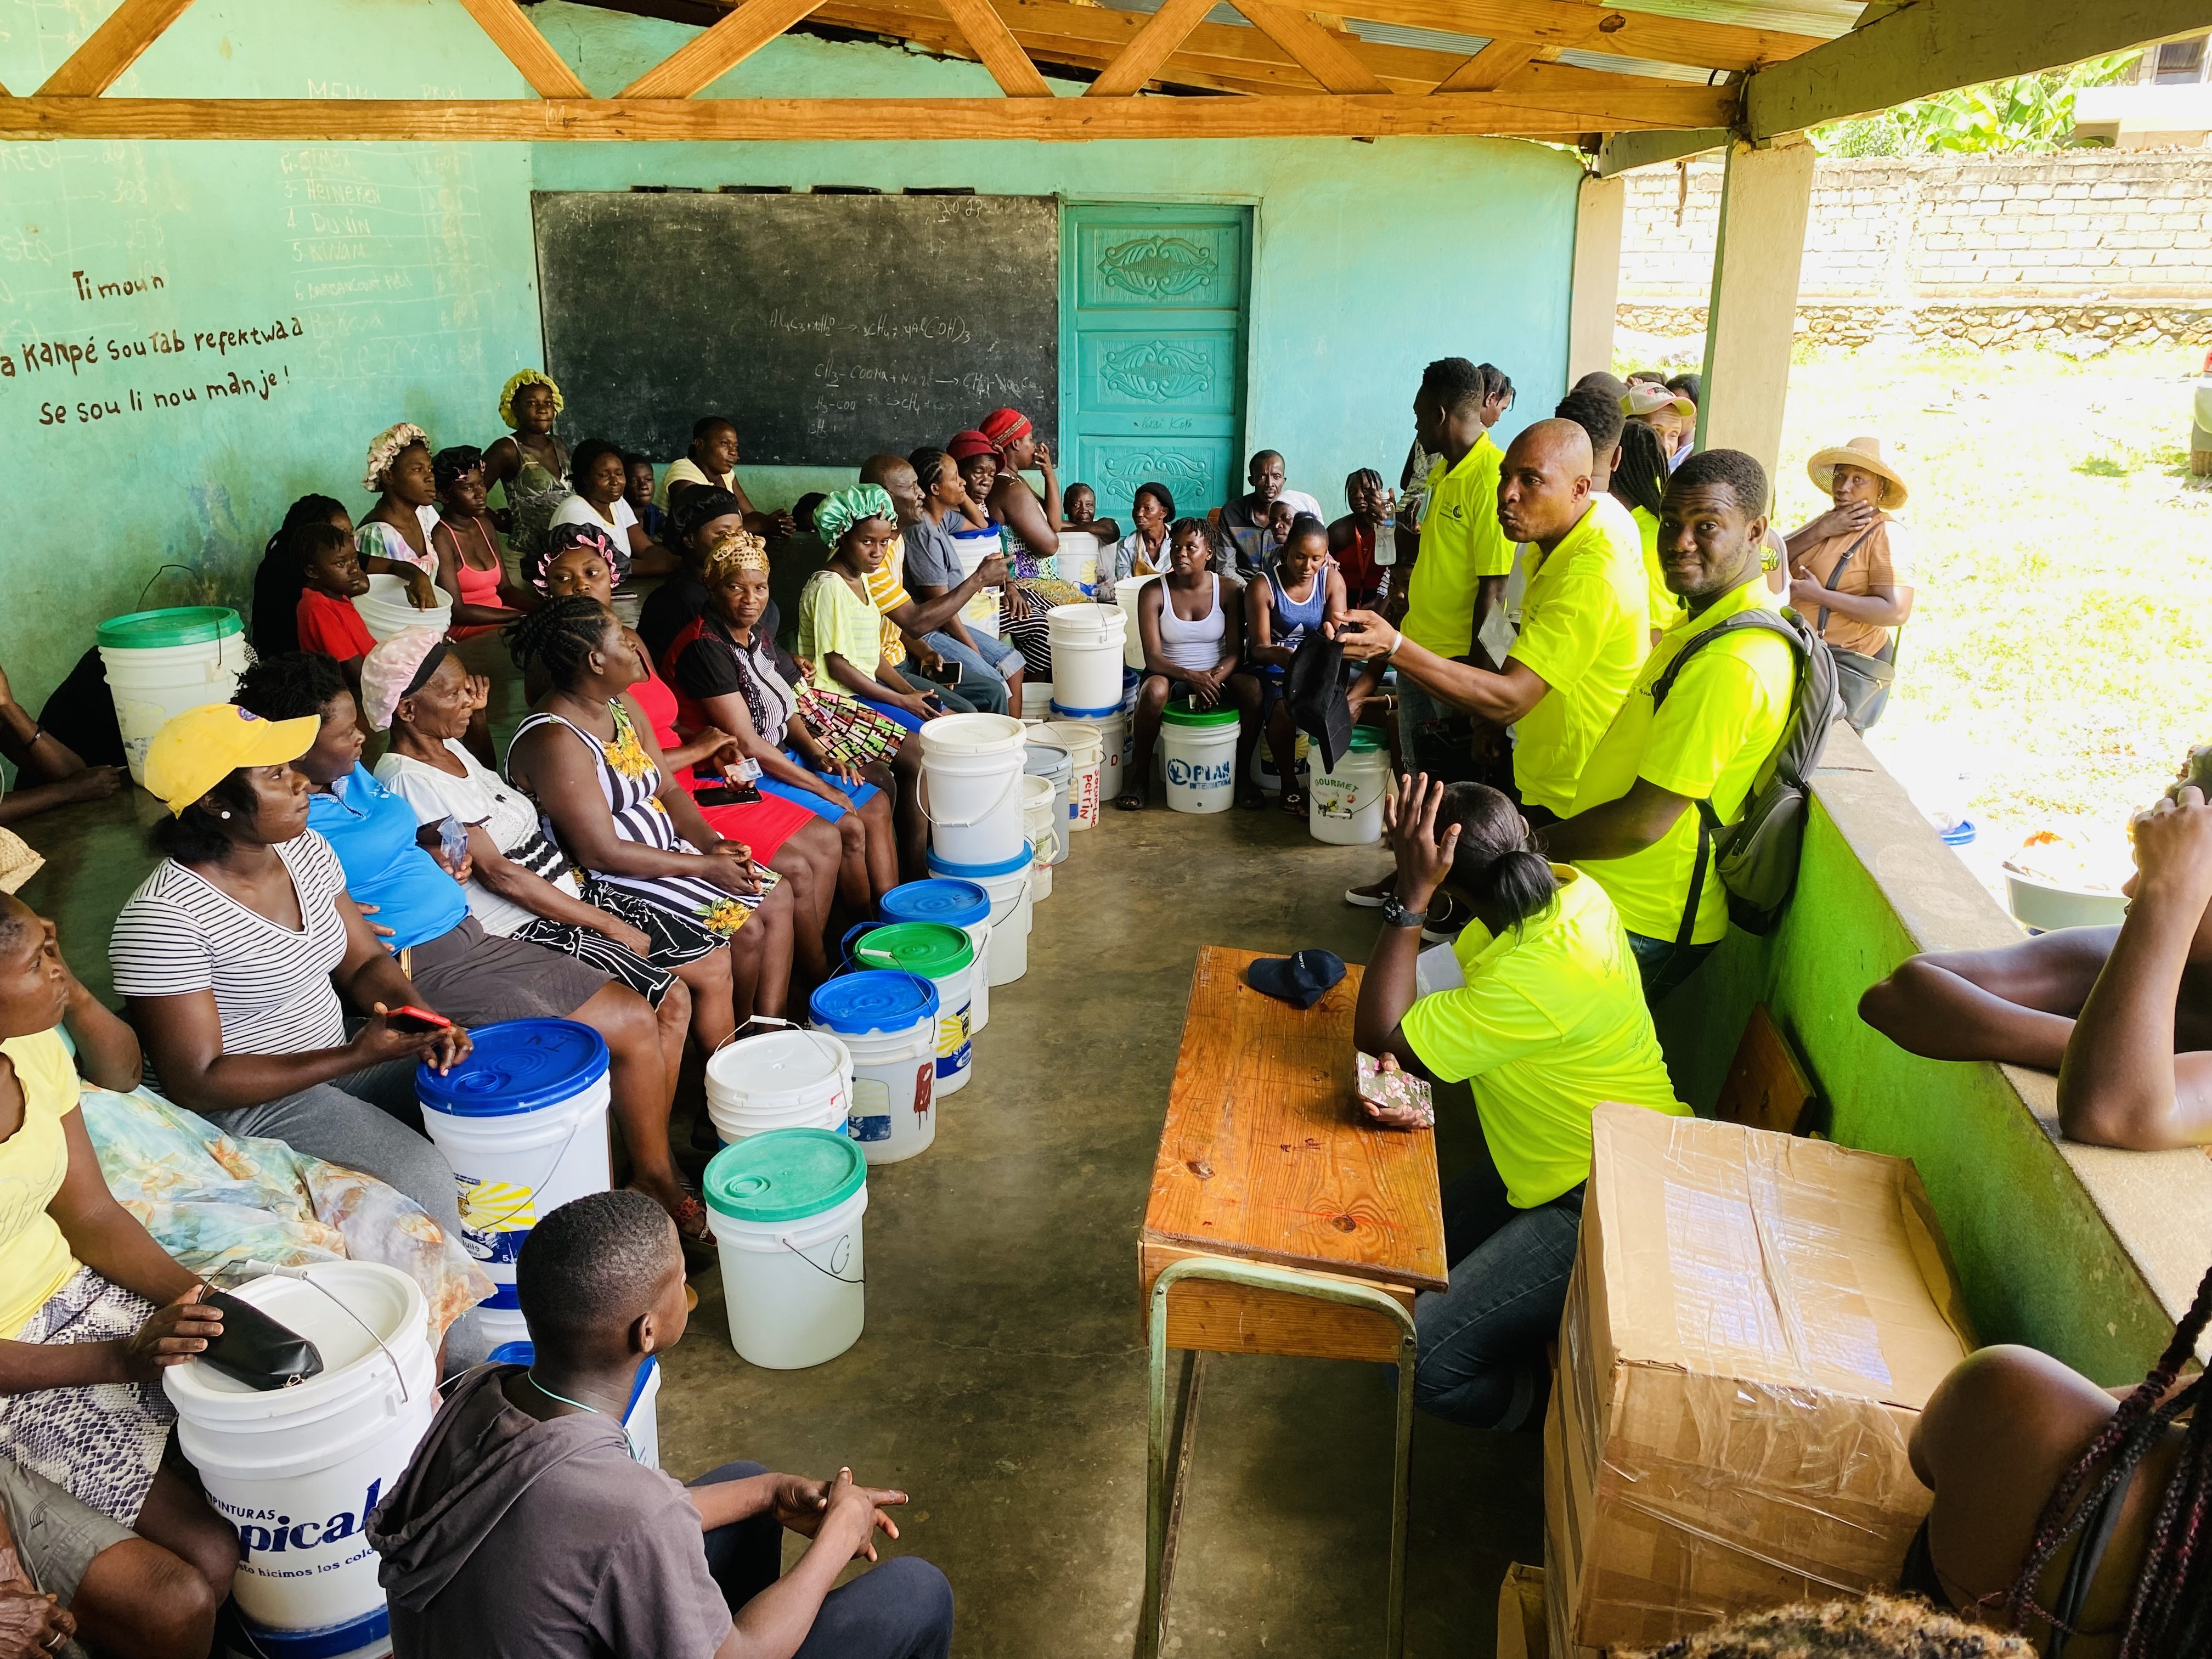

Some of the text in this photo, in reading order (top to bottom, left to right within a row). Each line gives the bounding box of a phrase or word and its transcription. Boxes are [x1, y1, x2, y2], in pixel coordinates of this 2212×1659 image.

[129, 388, 143, 411] li
[153, 387, 197, 408] nou
[1194, 761, 1230, 782] PLAN
[1314, 778, 1359, 793] GOURMET
[212, 1496, 275, 1520] PINTURAS
[258, 1567, 312, 1578] hicimos
[318, 1562, 340, 1573] los
